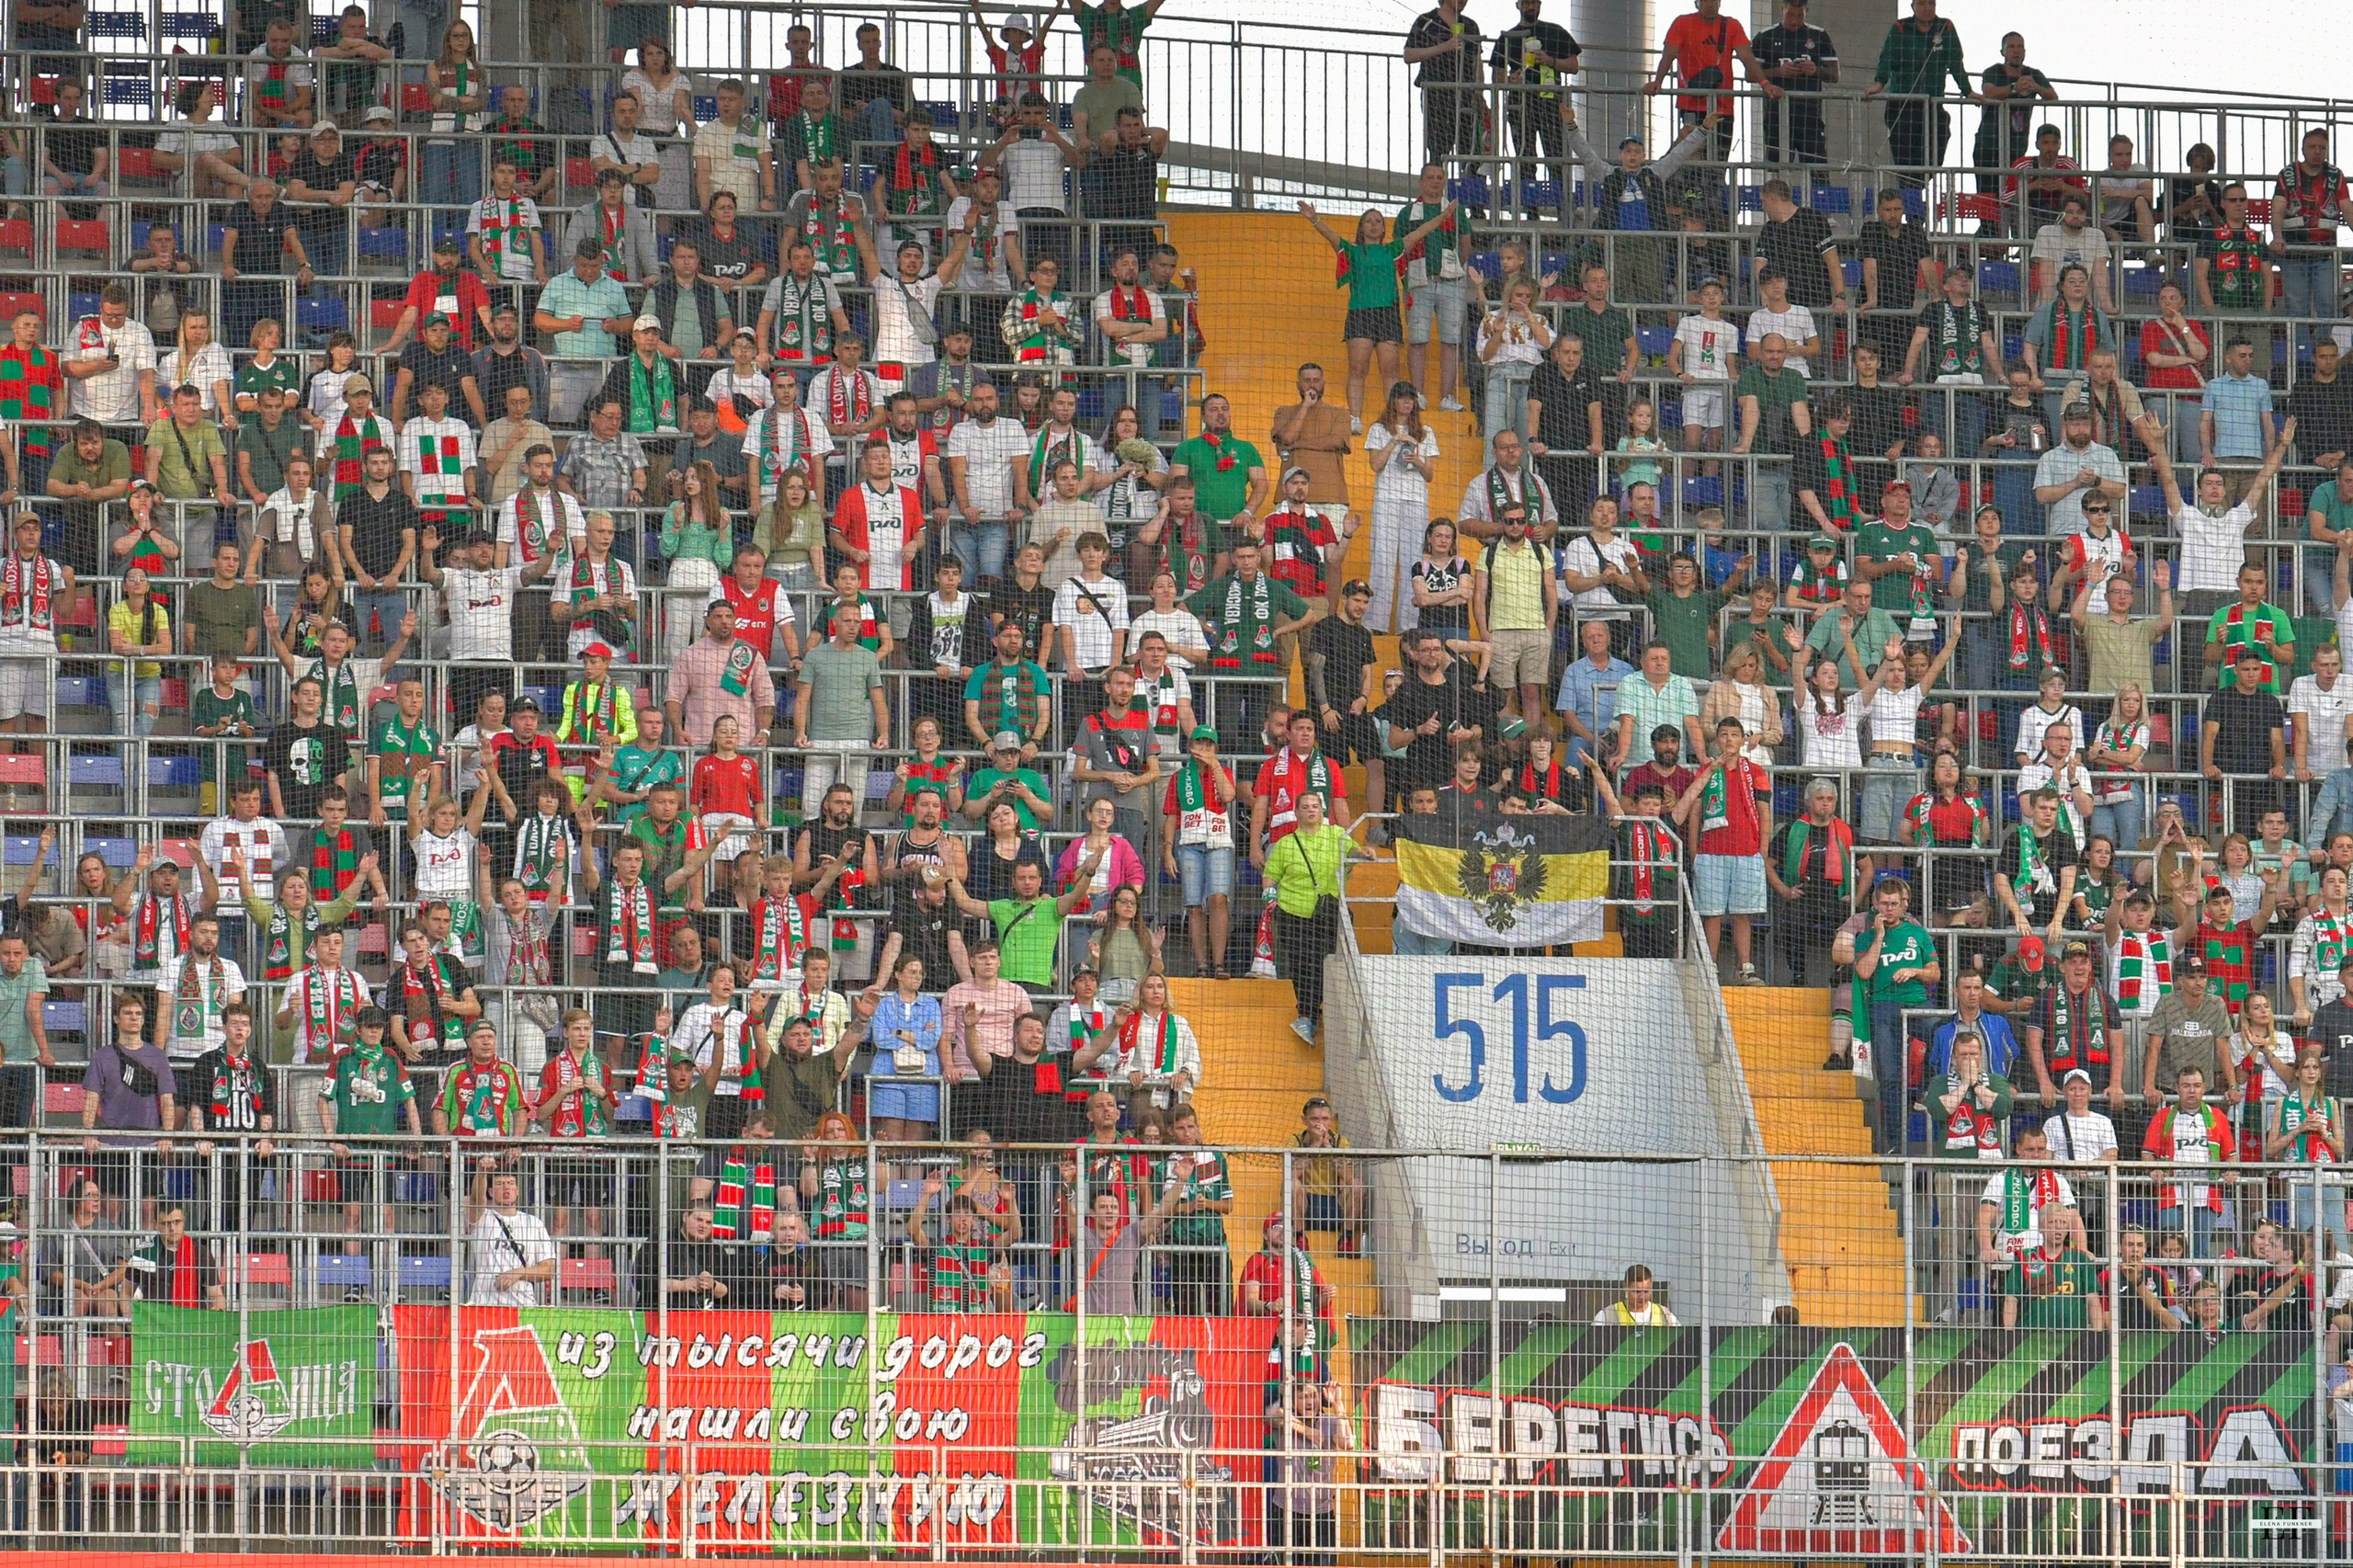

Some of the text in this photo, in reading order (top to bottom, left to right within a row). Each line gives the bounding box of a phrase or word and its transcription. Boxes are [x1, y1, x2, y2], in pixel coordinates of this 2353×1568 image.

[833, 412, 844, 426] FC
[869, 517, 902, 532] РЖД
[37, 583, 47, 597] FC
[1255, 600, 1268, 619] ФК
[1184, 813, 1202, 823] FON
[1184, 821, 1201, 829] BET
[1211, 817, 1226, 825] FON
[1211, 824, 1227, 833] BET
[1881, 948, 1916, 967] РЖД
[1433, 972, 1587, 1103] 515
[1457, 1233, 1532, 1258] Выод
[1375, 1381, 1731, 1483] БЕРЕГИСЬ
[1955, 1408, 2304, 1496] ПОЕЗДА
